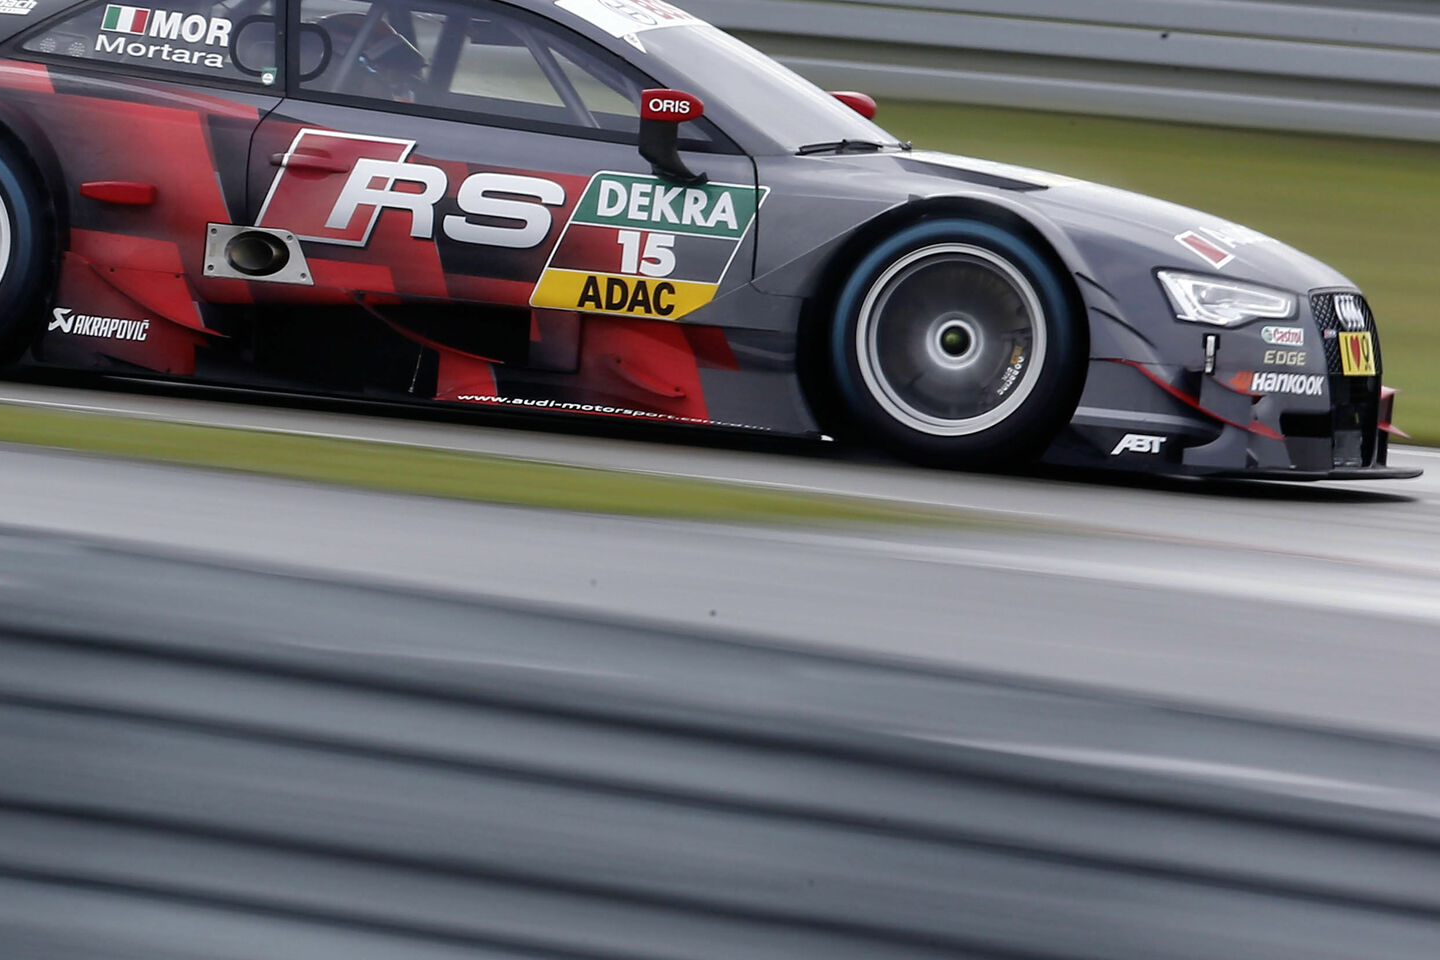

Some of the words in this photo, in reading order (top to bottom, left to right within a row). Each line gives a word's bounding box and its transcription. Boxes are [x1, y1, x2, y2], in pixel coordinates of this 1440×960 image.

[148, 9, 232, 47] MOR
[95, 34, 224, 68] Mortara
[649, 97, 690, 114] ORIS
[325, 157, 566, 248] RS
[596, 179, 738, 230] DEKRA
[617, 230, 676, 277] 15
[577, 276, 675, 316] ADAC
[1264, 350, 1306, 366] EDGE
[1111, 433, 1167, 455] ABT
